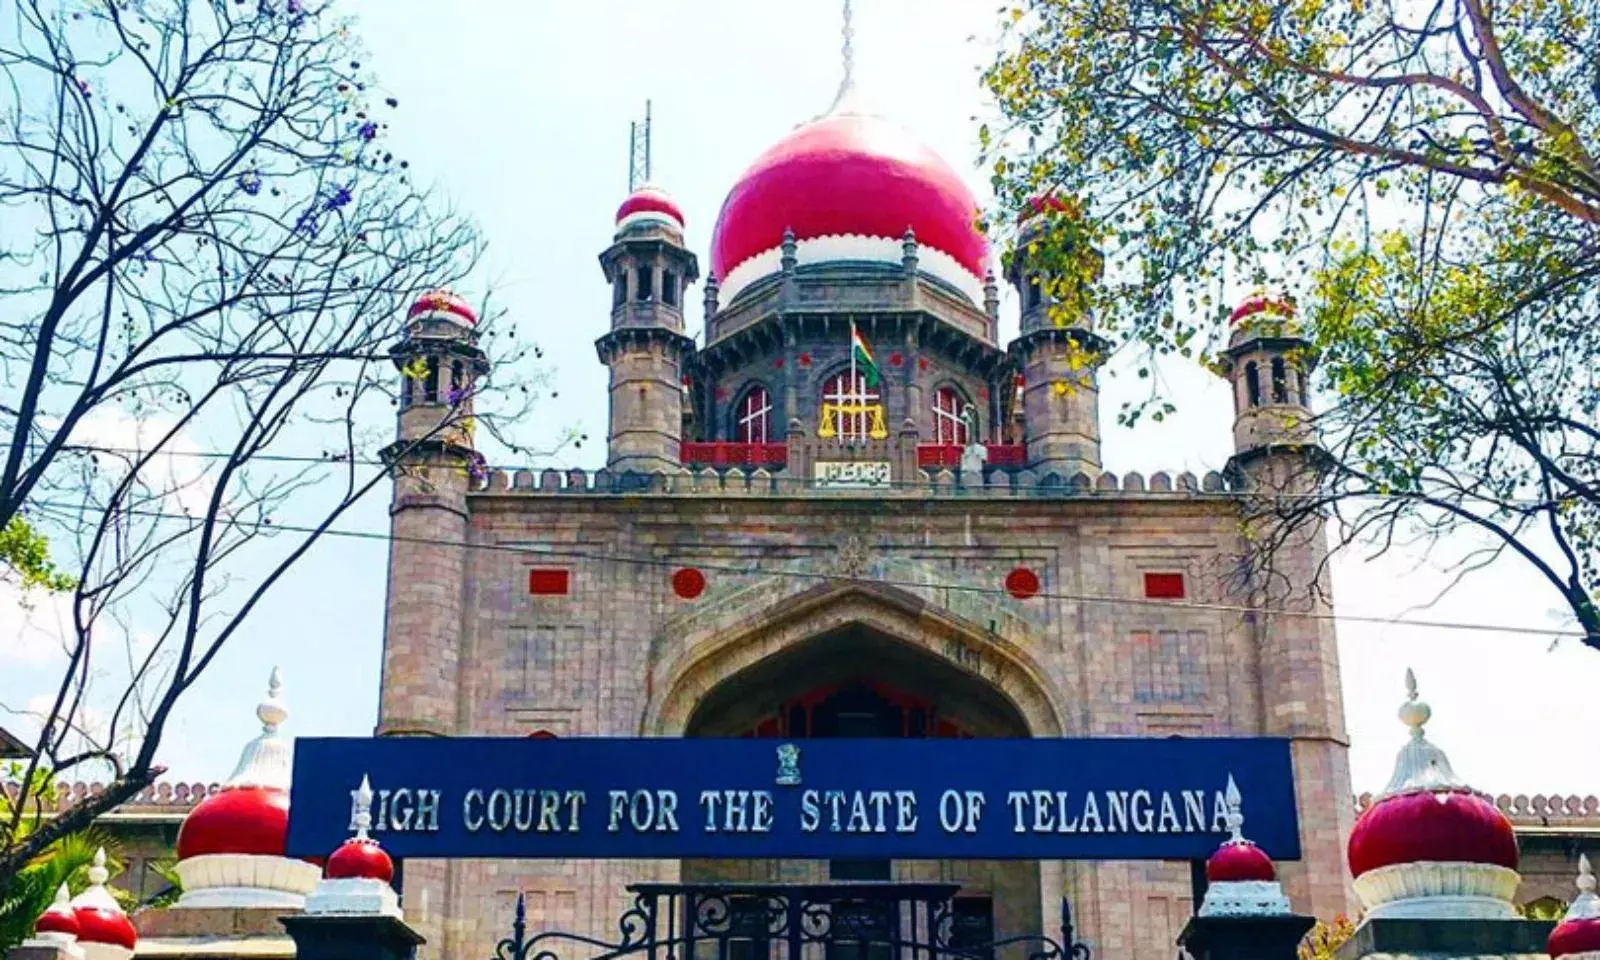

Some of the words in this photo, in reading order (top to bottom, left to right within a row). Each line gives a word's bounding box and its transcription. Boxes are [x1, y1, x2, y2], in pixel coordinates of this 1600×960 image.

[464, 789, 586, 830] COURT
[607, 789, 679, 831] FOR
[700, 789, 774, 831] THE
[801, 789, 917, 832] STATE
[939, 789, 985, 832] OF
[1007, 789, 1234, 832] TELANGANA
